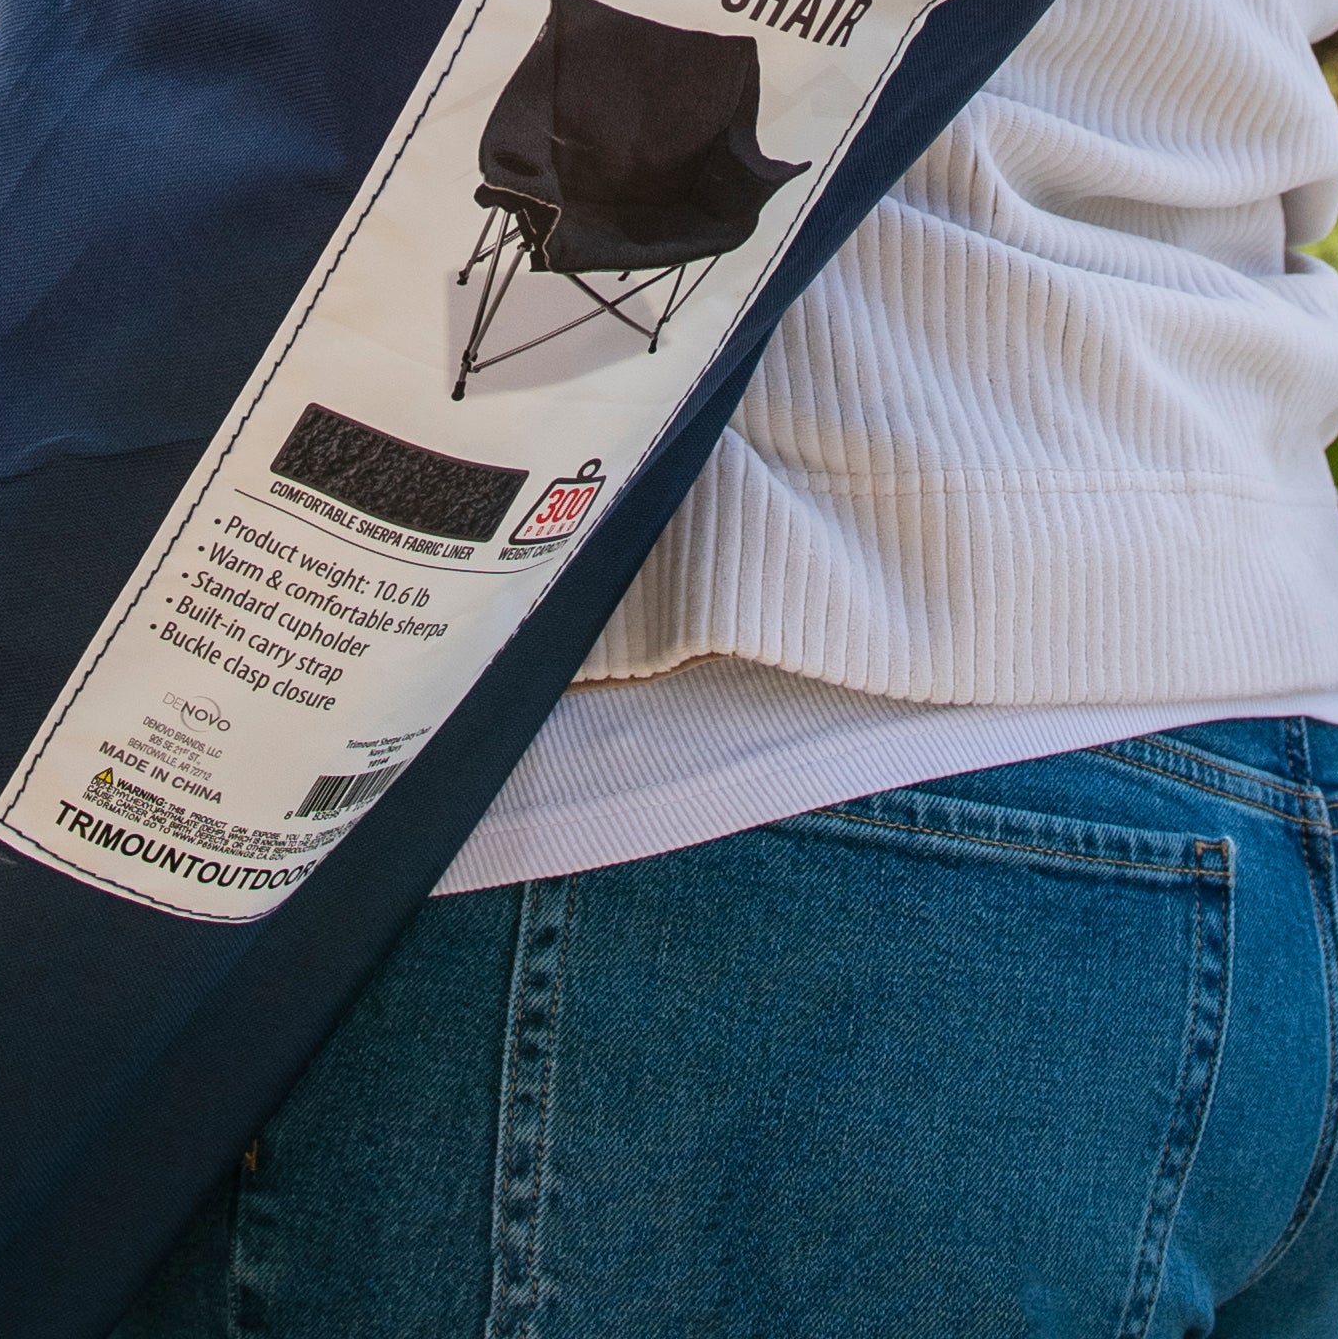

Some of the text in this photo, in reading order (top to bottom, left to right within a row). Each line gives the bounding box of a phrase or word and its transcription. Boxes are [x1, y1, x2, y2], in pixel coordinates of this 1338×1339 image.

[270, 481, 475, 561] COMFORTABLE SHERPA FABRIC LINER
[536, 487, 594, 524] 300
[224, 514, 430, 608] Product weight: 10.6 lb
[498, 546, 536, 560] WEIGHT
[209, 542, 448, 641] Warm & comfortable sherpa
[191, 571, 371, 658] Standard cupholder
[176, 595, 343, 686] Built-in carry strap
[160, 621, 336, 711] Buckle clasp closure
[162, 692, 231, 732] DENOVO
[127, 737, 212, 781] BENTONVILLE, AR 72712
[142, 716, 223, 759] DENOVO BRANDS, LLC
[148, 734, 163, 745] 905
[162, 739, 173, 751] SE
[99, 741, 223, 804] MADE IN CHINA
[82, 792, 141, 823] INFORMATION
[143, 819, 157, 829] GO
[158, 825, 171, 834] TO
[86, 784, 115, 801] CAUSE
[115, 799, 149, 817] CANCER
[149, 814, 167, 824] AND
[116, 778, 167, 808] WARNING:
[168, 803, 186, 815] THIS
[190, 812, 228, 829] PRODUCT
[231, 825, 248, 835] CAN
[283, 811, 294, 820] 8
